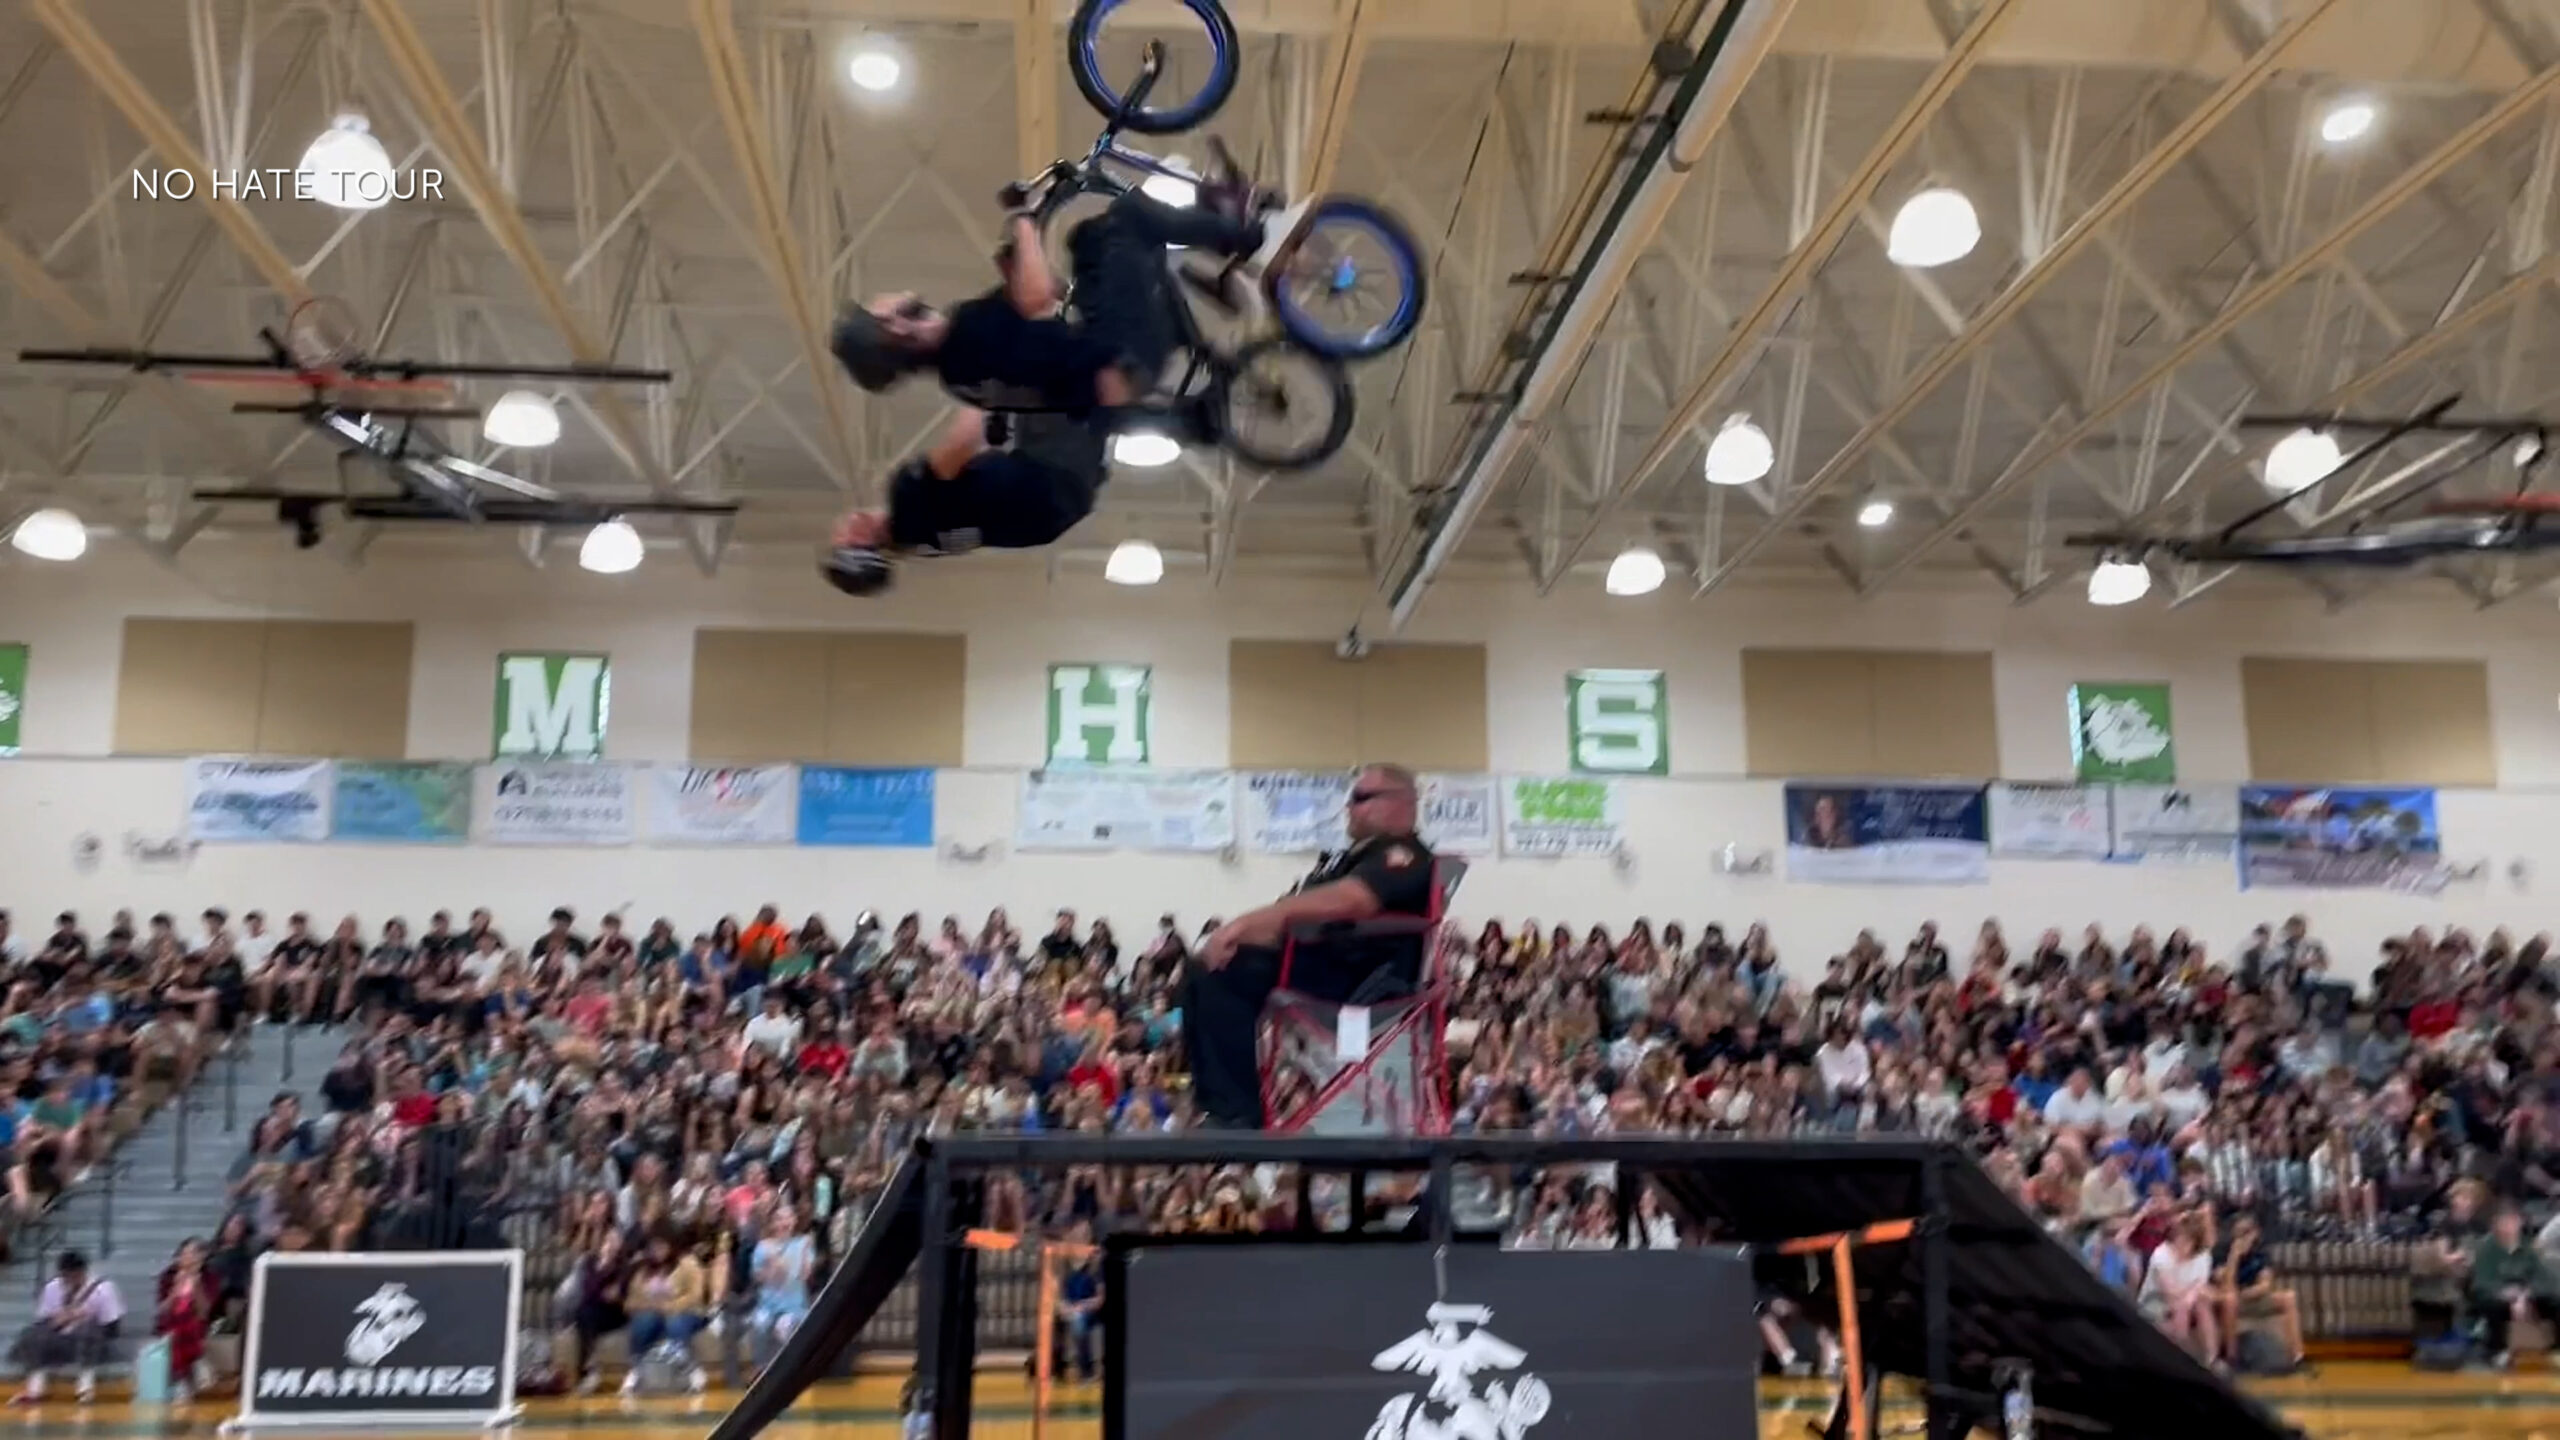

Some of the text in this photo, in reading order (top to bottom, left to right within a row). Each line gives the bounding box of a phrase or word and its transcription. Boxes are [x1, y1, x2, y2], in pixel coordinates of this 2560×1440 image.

[500, 656, 603, 755] M
[1052, 666, 1145, 763] H
[1577, 680, 1659, 770] S
[256, 1365, 497, 1399] MARINES
